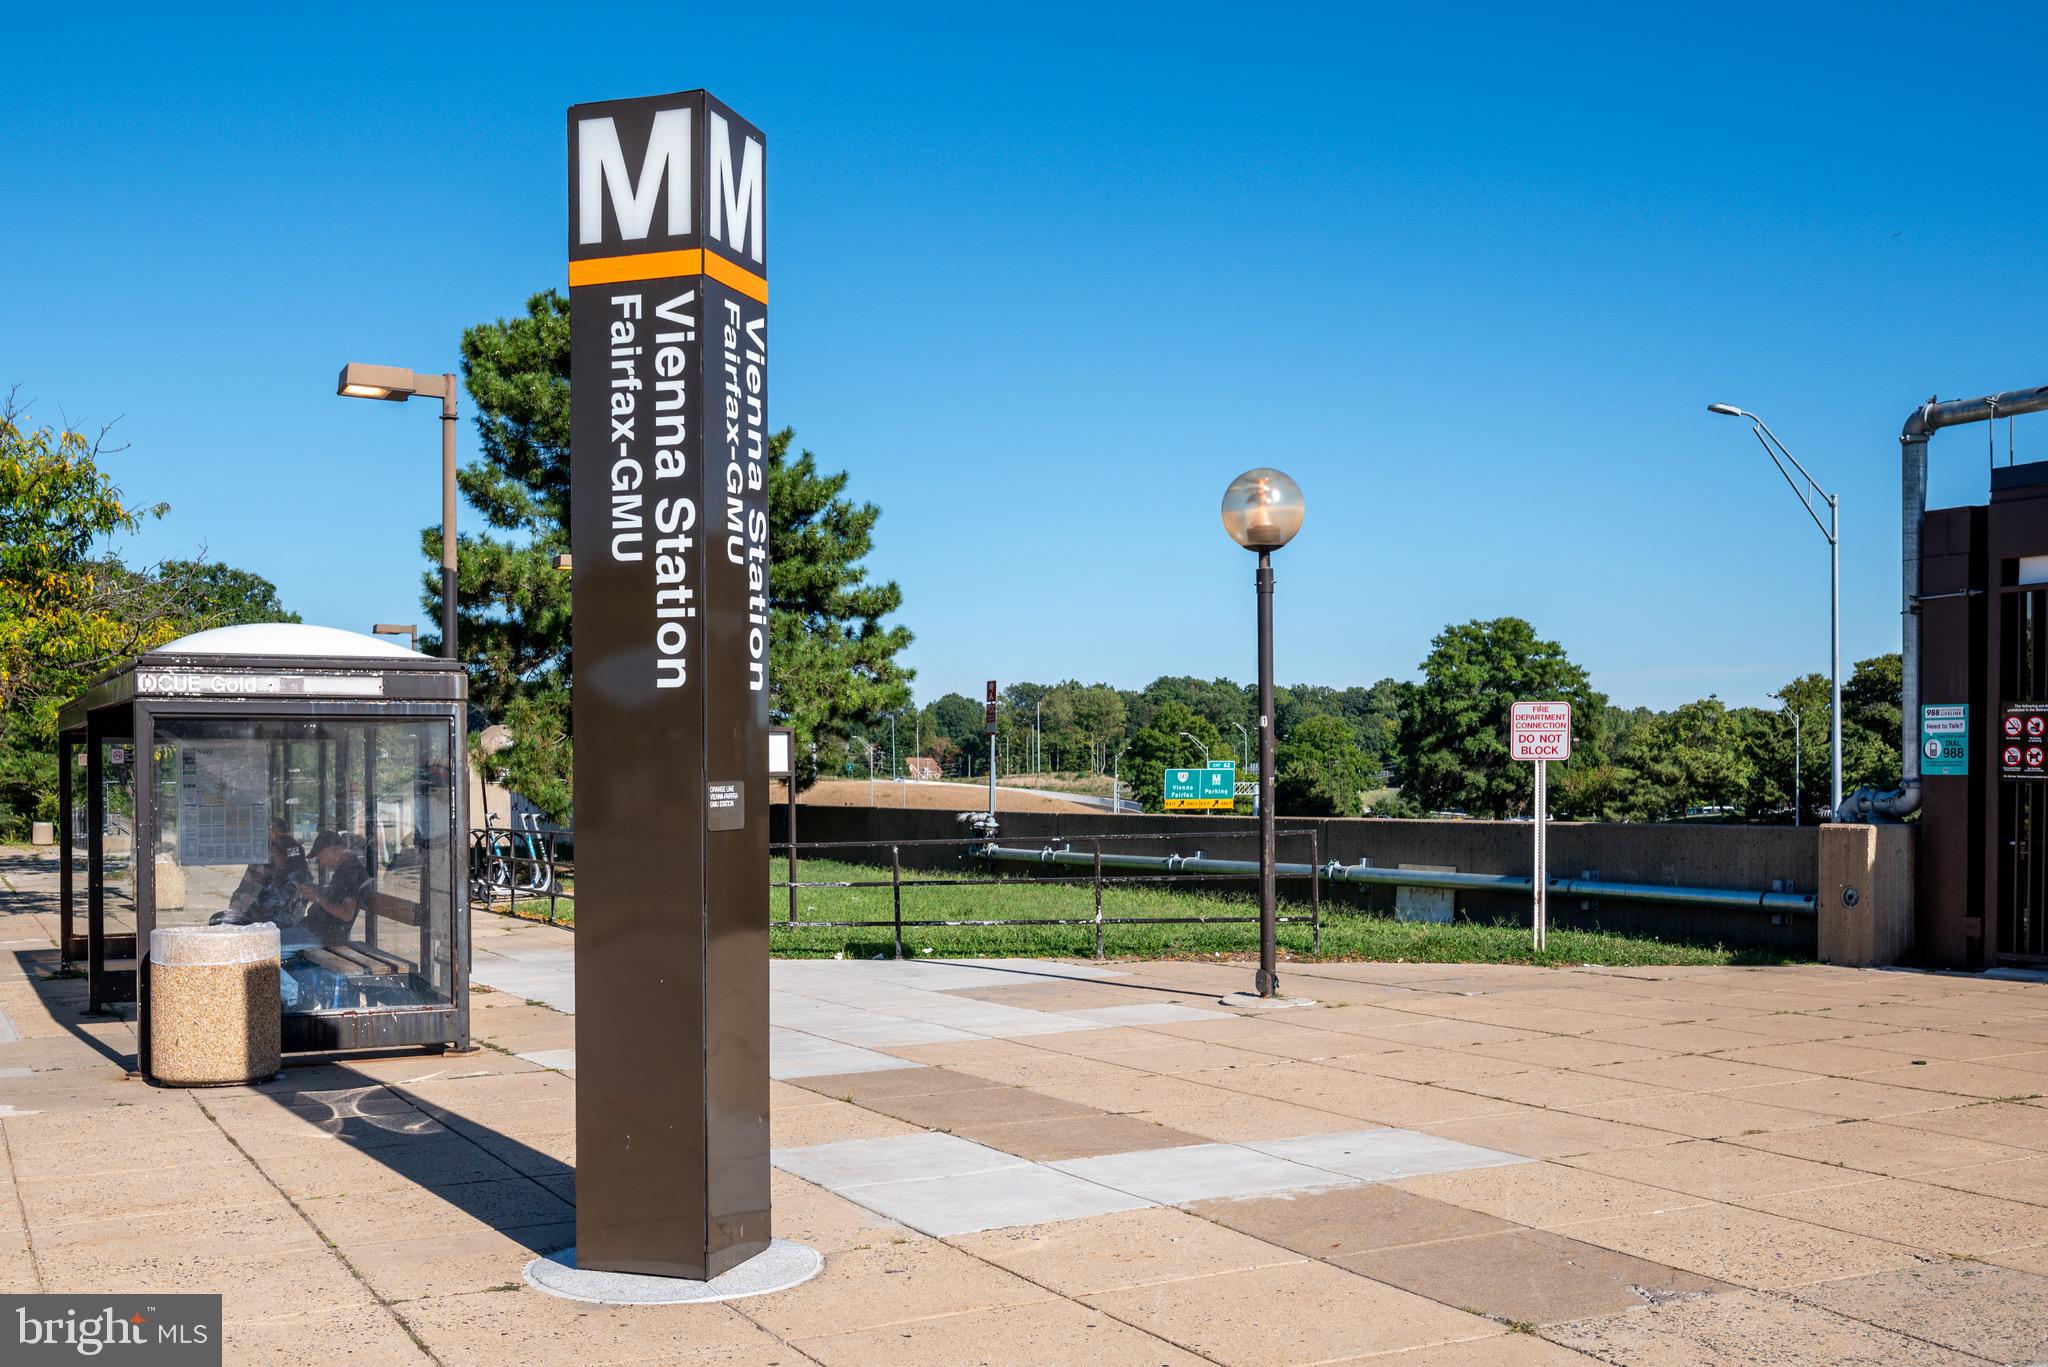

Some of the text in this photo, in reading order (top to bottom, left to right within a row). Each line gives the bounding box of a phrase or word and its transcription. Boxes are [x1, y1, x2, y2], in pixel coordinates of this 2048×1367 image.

[579, 108, 691, 245] M
[709, 110, 763, 265] M
[611, 294, 643, 562] Fairfax-GMU
[655, 289, 696, 689] Vienna Station
[724, 298, 744, 565] Fairfax-GMU
[745, 318, 768, 691] Vienna Station
[210, 675, 257, 693] Gold
[1518, 734, 1562, 743] DO NOT
[1521, 746, 1559, 755] BLOCK
[1943, 747, 1964, 758] 988
